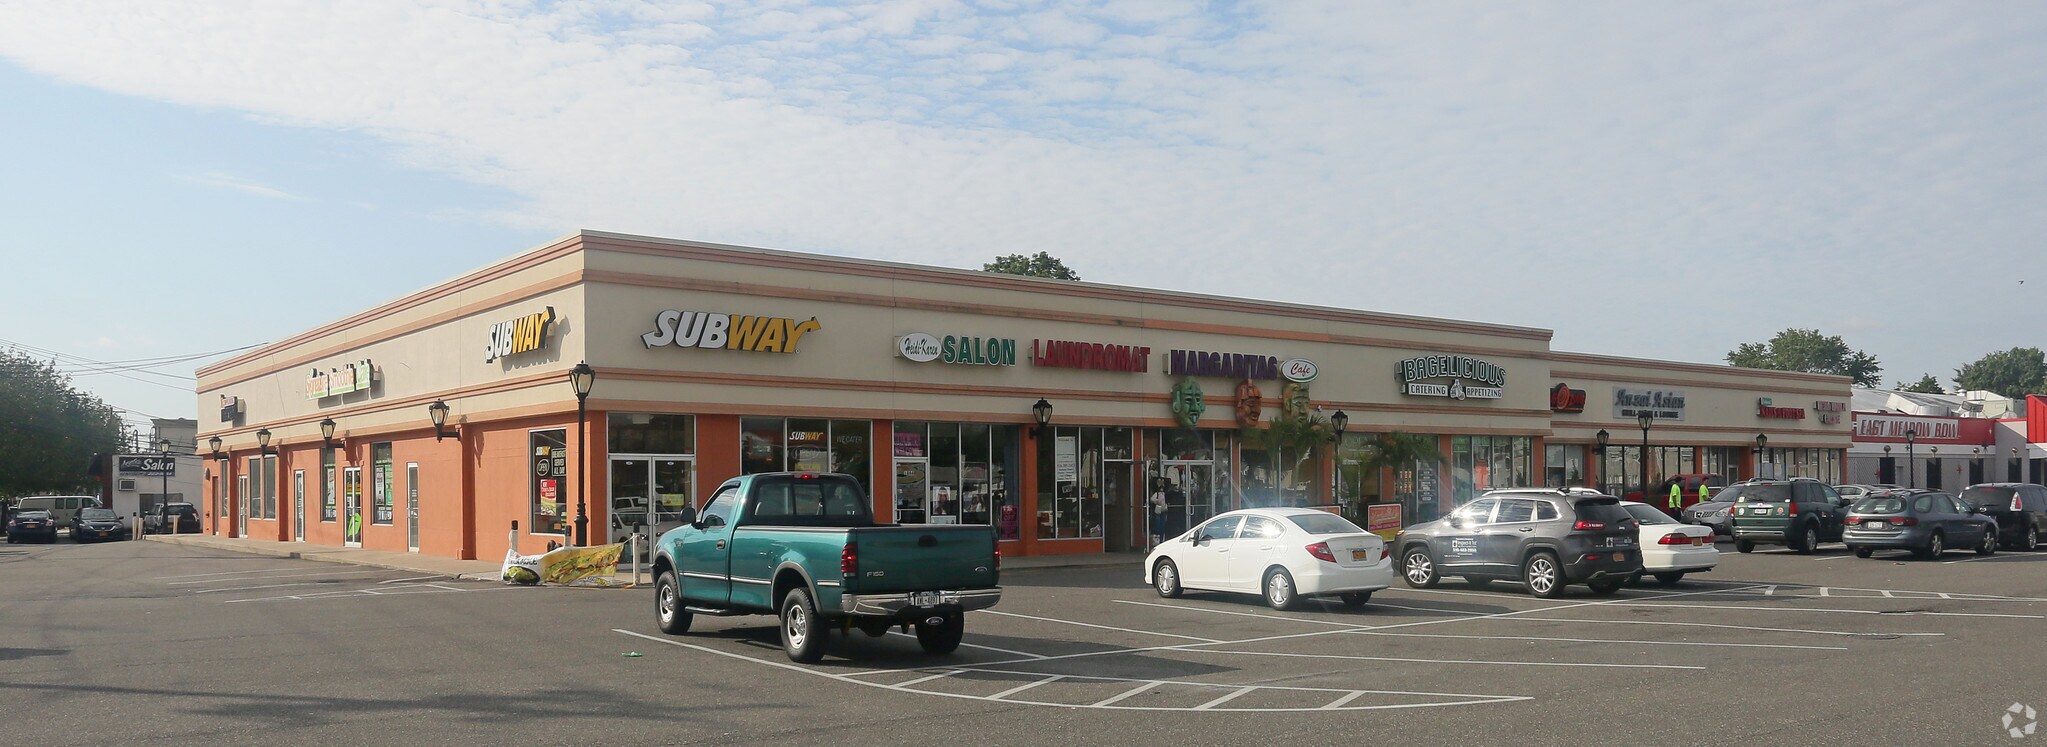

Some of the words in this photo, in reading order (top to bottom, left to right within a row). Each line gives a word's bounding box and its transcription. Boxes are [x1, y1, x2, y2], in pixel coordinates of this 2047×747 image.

[484, 307, 556, 363] SUBWAY
[641, 309, 822, 353] SUBWAY
[942, 335, 1016, 366] SALON
[1033, 338, 1151, 373] LAUNDROMAT
[1168, 349, 1278, 381] MARGARITAS
[1290, 361, 1311, 377] Cafe
[1404, 355, 1506, 388] BAGELICIOUS
[1410, 384, 1446, 395] CATERING
[1466, 387, 1502, 397] APPETIZING
[789, 431, 824, 440] SUBWAY
[1859, 420, 1885, 436] EAST
